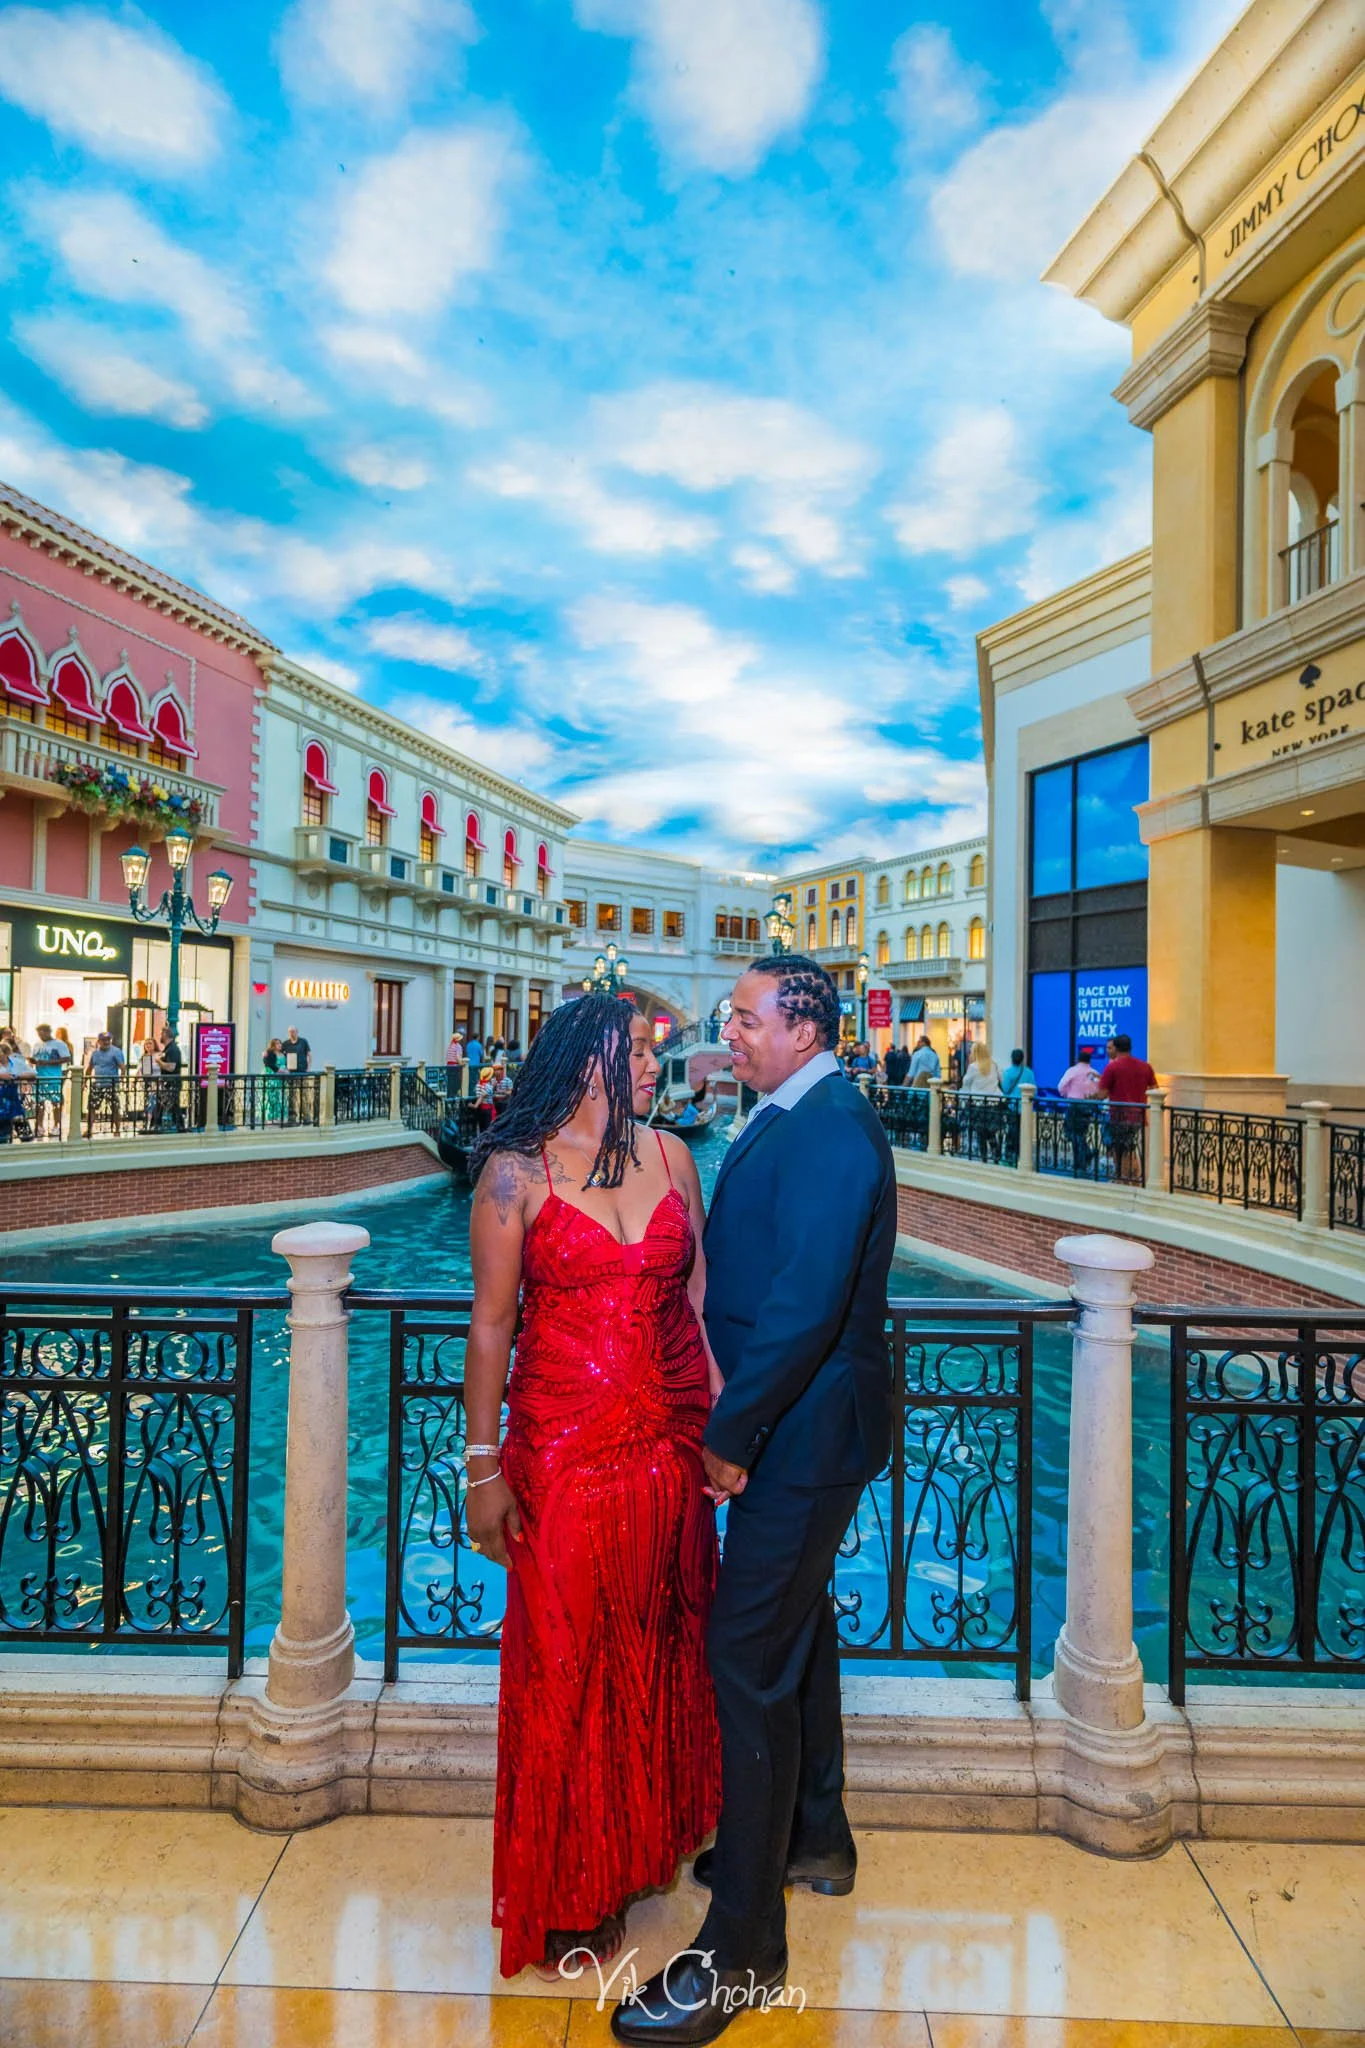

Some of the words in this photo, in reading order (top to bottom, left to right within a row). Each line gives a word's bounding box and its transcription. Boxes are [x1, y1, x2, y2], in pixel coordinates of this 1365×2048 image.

[1224, 173, 1287, 258] JIMMY
[1296, 93, 1365, 180] CHO
[1241, 710, 1295, 745] kate
[287, 979, 350, 1001] CANALETTO
[1078, 986, 1105, 997] RACE
[1108, 984, 1130, 996] DAY
[1078, 999, 1088, 1008] IS
[1090, 996, 1132, 1008] BETTER
[1078, 1009, 1113, 1022] WITH
[1078, 1024, 1117, 1037] AMEX
